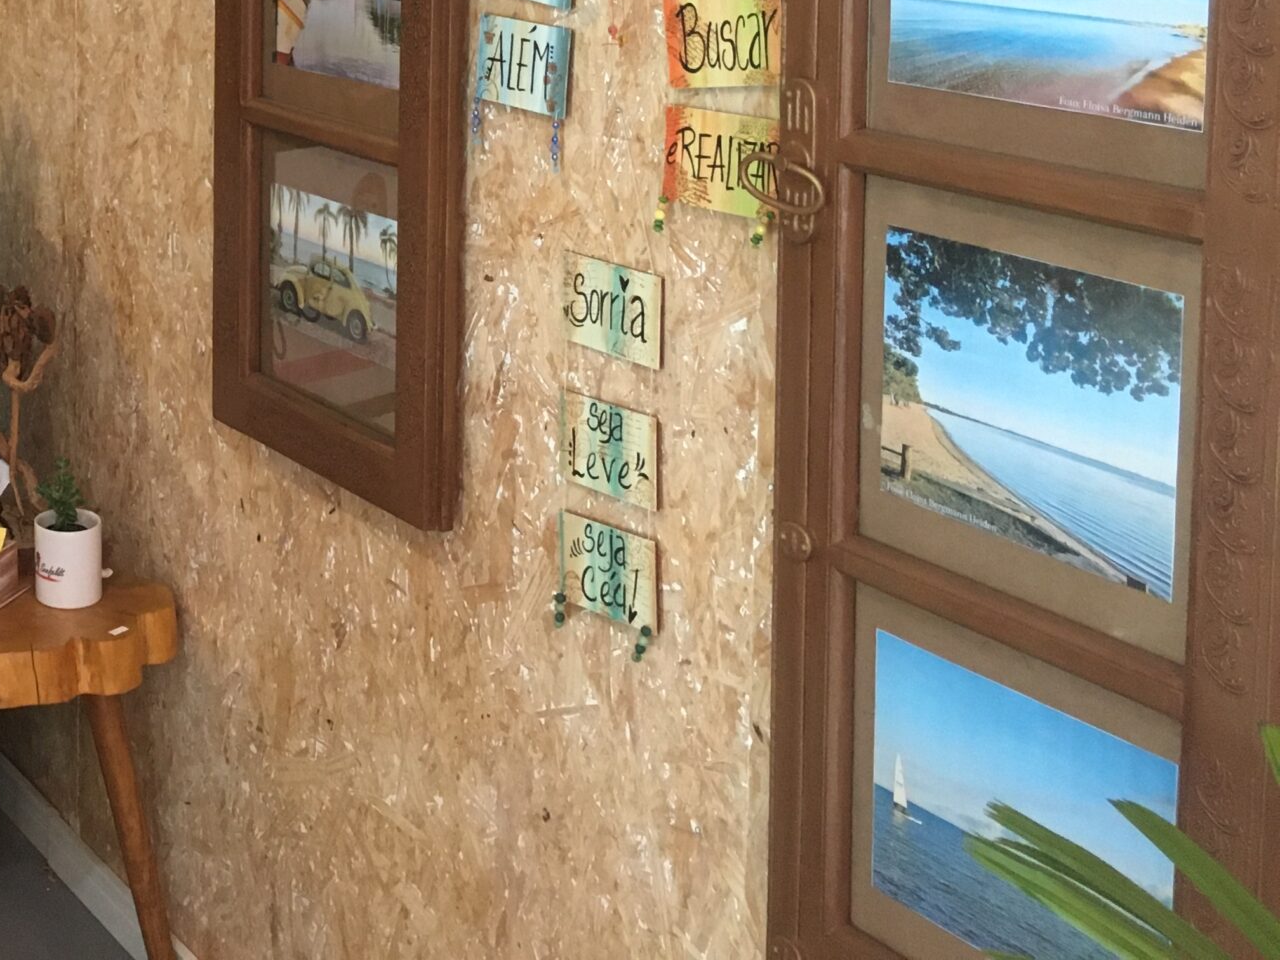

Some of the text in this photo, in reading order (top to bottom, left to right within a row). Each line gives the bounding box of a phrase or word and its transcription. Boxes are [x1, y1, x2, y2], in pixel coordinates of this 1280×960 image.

[486, 26, 550, 99] ALÉM
[676, 2, 777, 74] Buscar
[1112, 103, 1161, 121] Bergmann
[569, 273, 648, 344] Sorria
